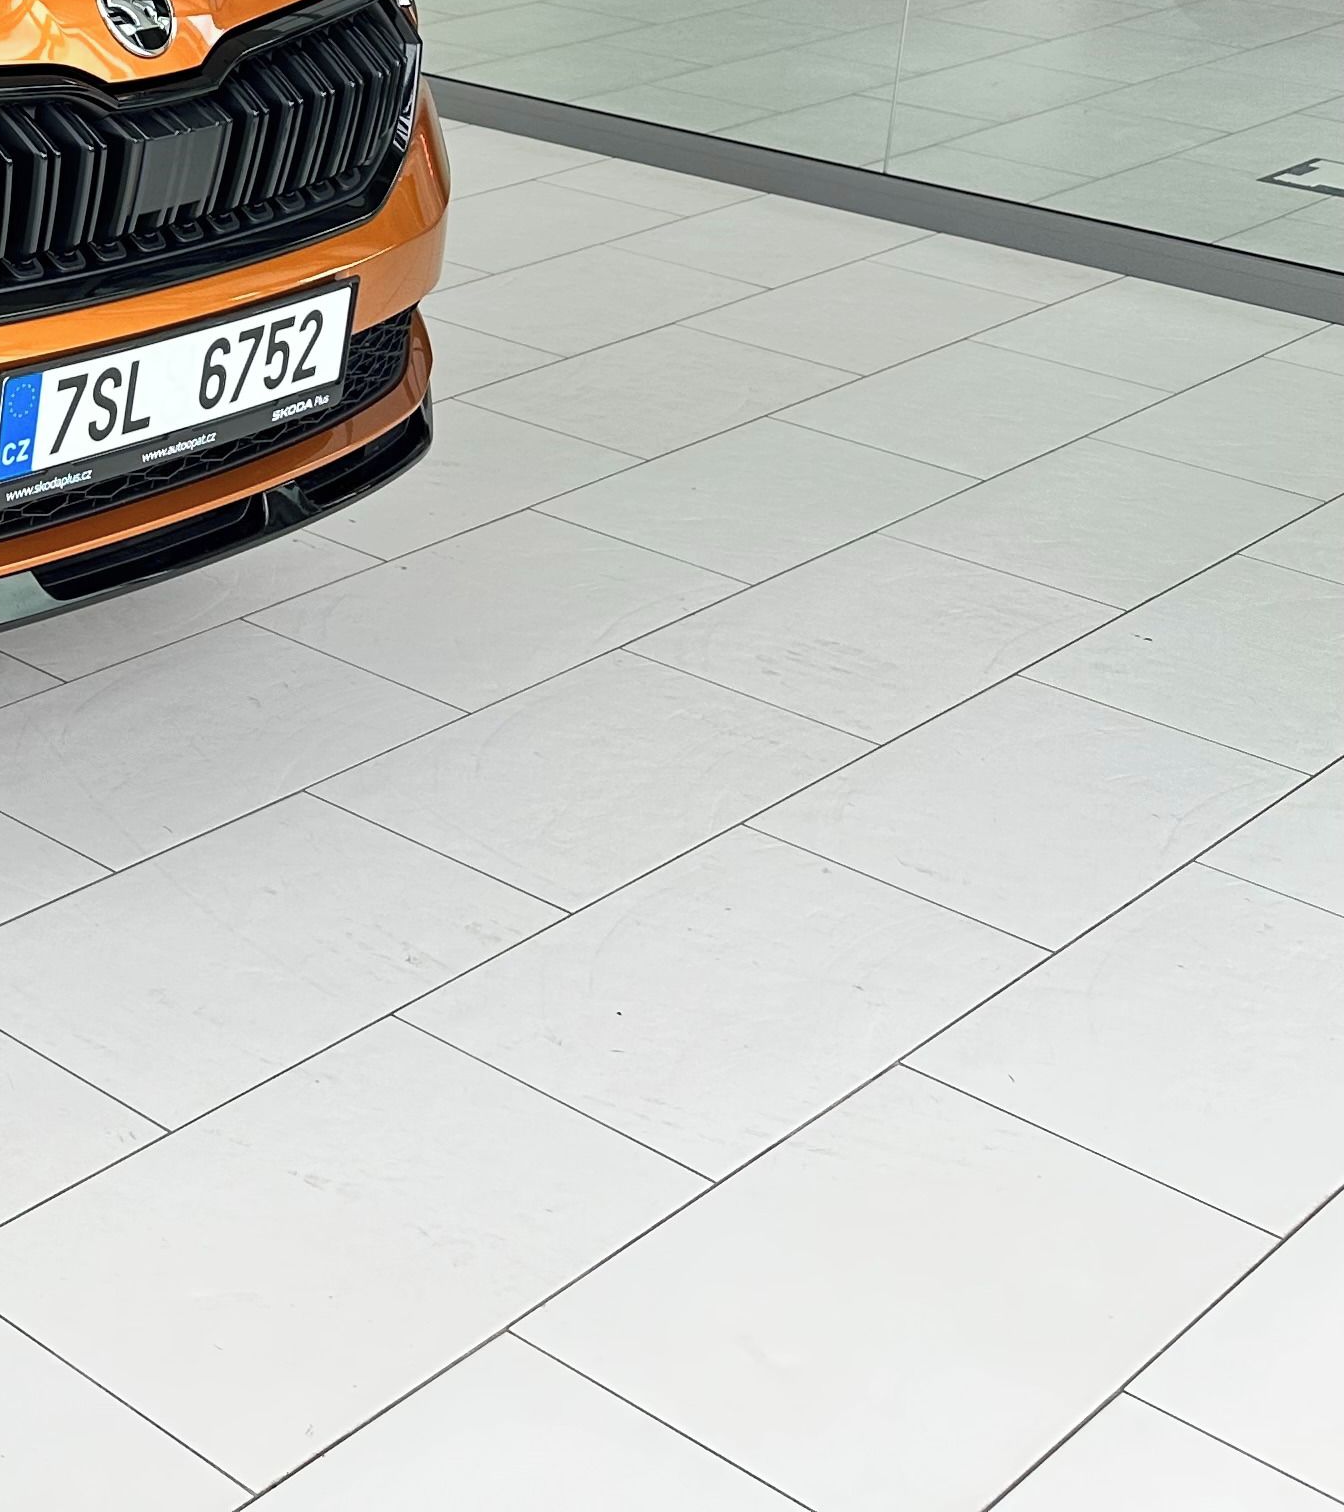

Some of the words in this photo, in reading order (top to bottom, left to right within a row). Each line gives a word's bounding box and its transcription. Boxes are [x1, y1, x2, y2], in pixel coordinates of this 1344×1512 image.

[49, 360, 151, 455] 7SL
[197, 309, 325, 410] 6752
[1, 439, 31, 467] CZ
[141, 431, 218, 464] www.autoopat.cz
[4, 468, 93, 502] www.skodaplus.cz
